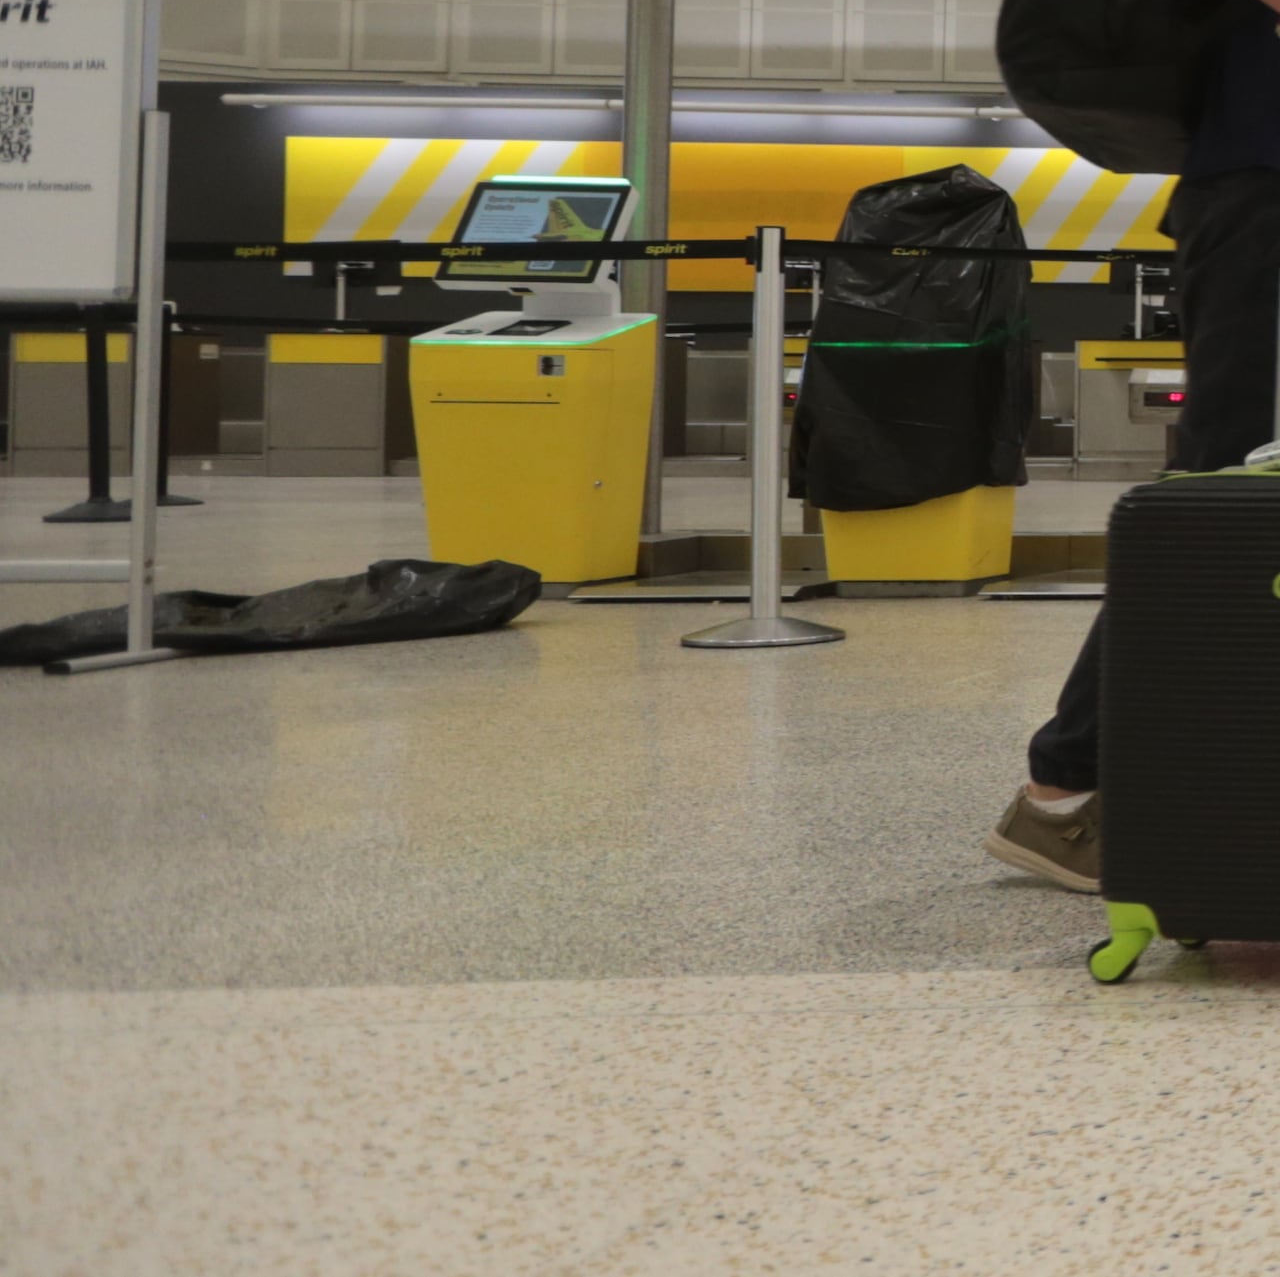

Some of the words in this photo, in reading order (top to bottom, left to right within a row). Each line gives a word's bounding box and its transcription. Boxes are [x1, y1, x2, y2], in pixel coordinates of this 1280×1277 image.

[234, 245, 278, 257] spirit
[441, 246, 485, 257] spirit
[645, 244, 687, 255] spirit
